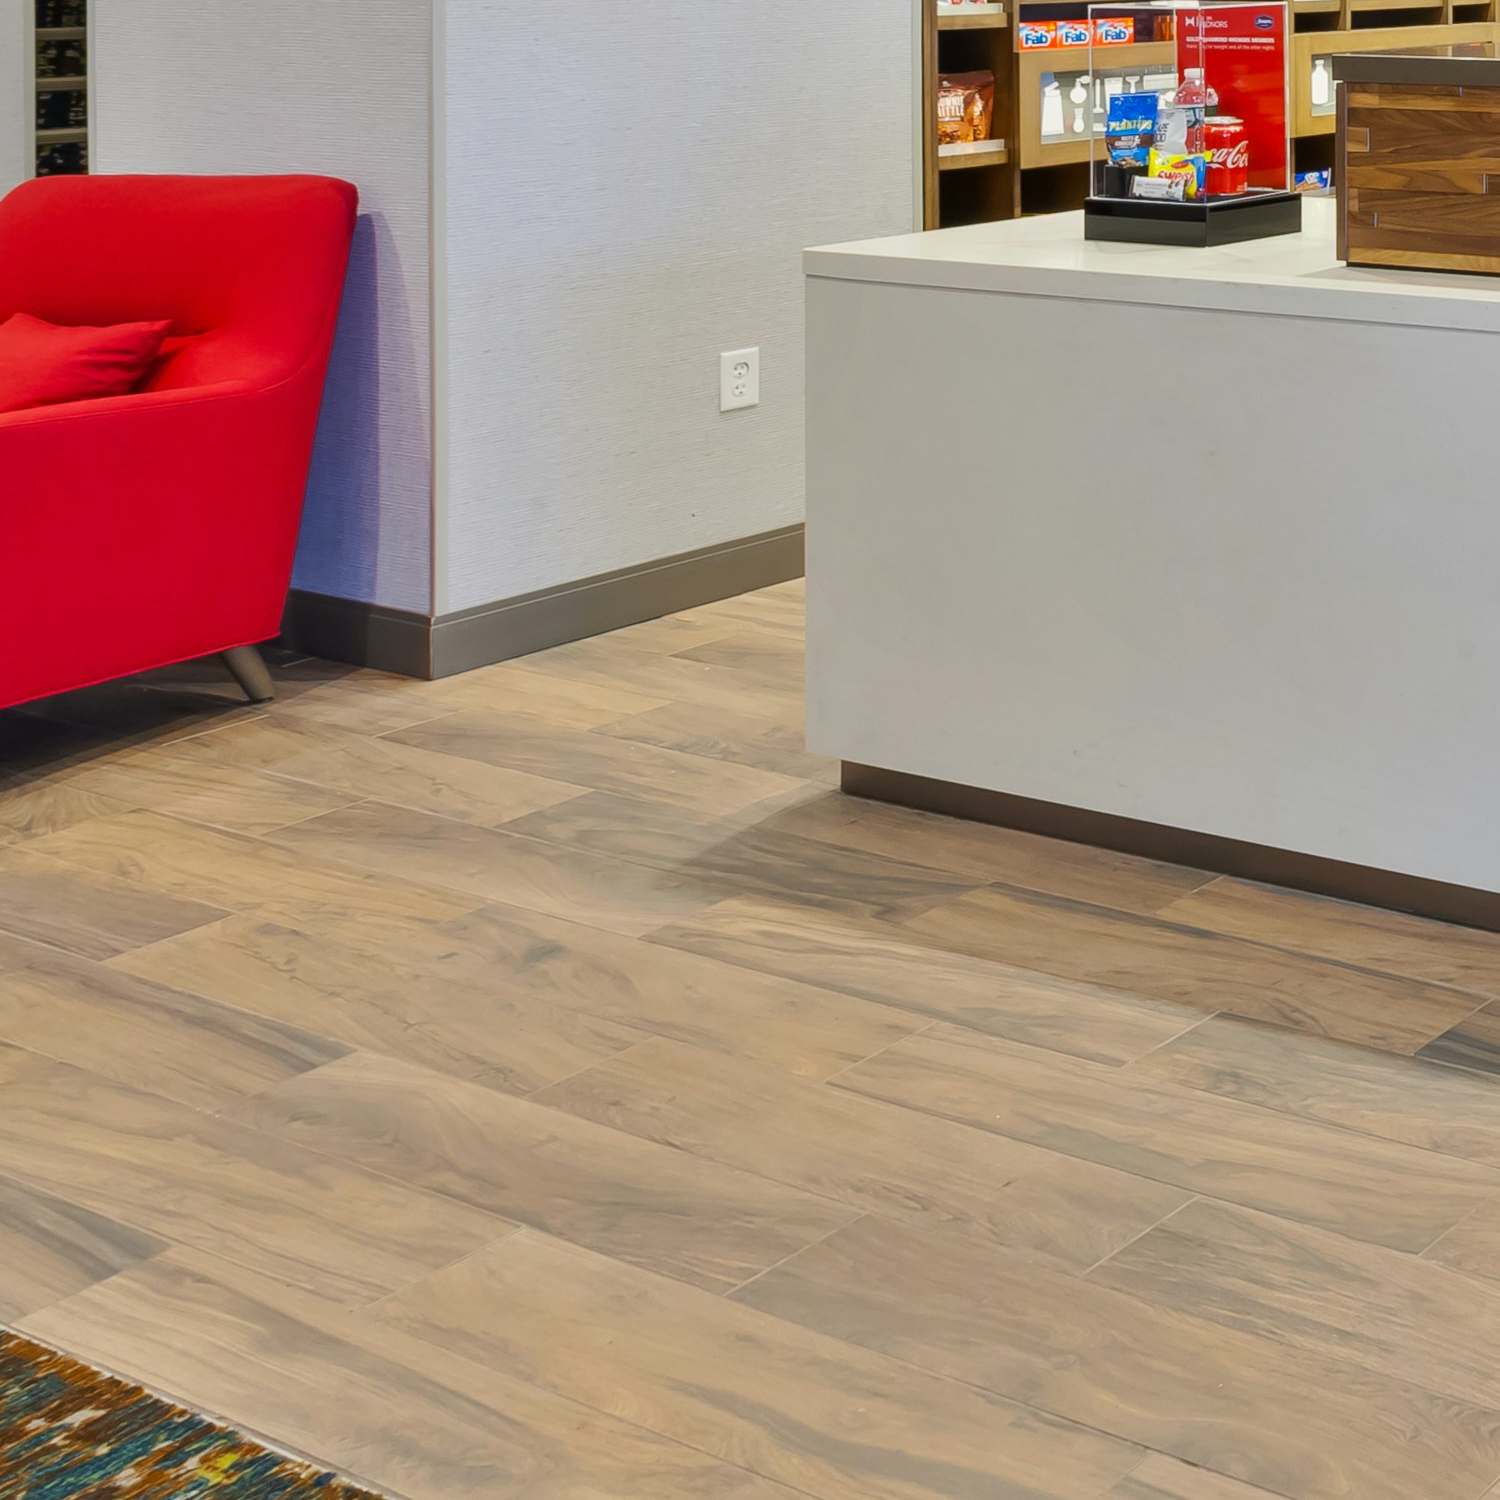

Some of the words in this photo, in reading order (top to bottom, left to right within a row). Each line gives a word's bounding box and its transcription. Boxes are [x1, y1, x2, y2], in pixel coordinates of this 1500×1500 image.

[1024, 32, 1049, 45] Fab
[1064, 30, 1088, 43] Fab
[1104, 28, 1127, 41] Fab
